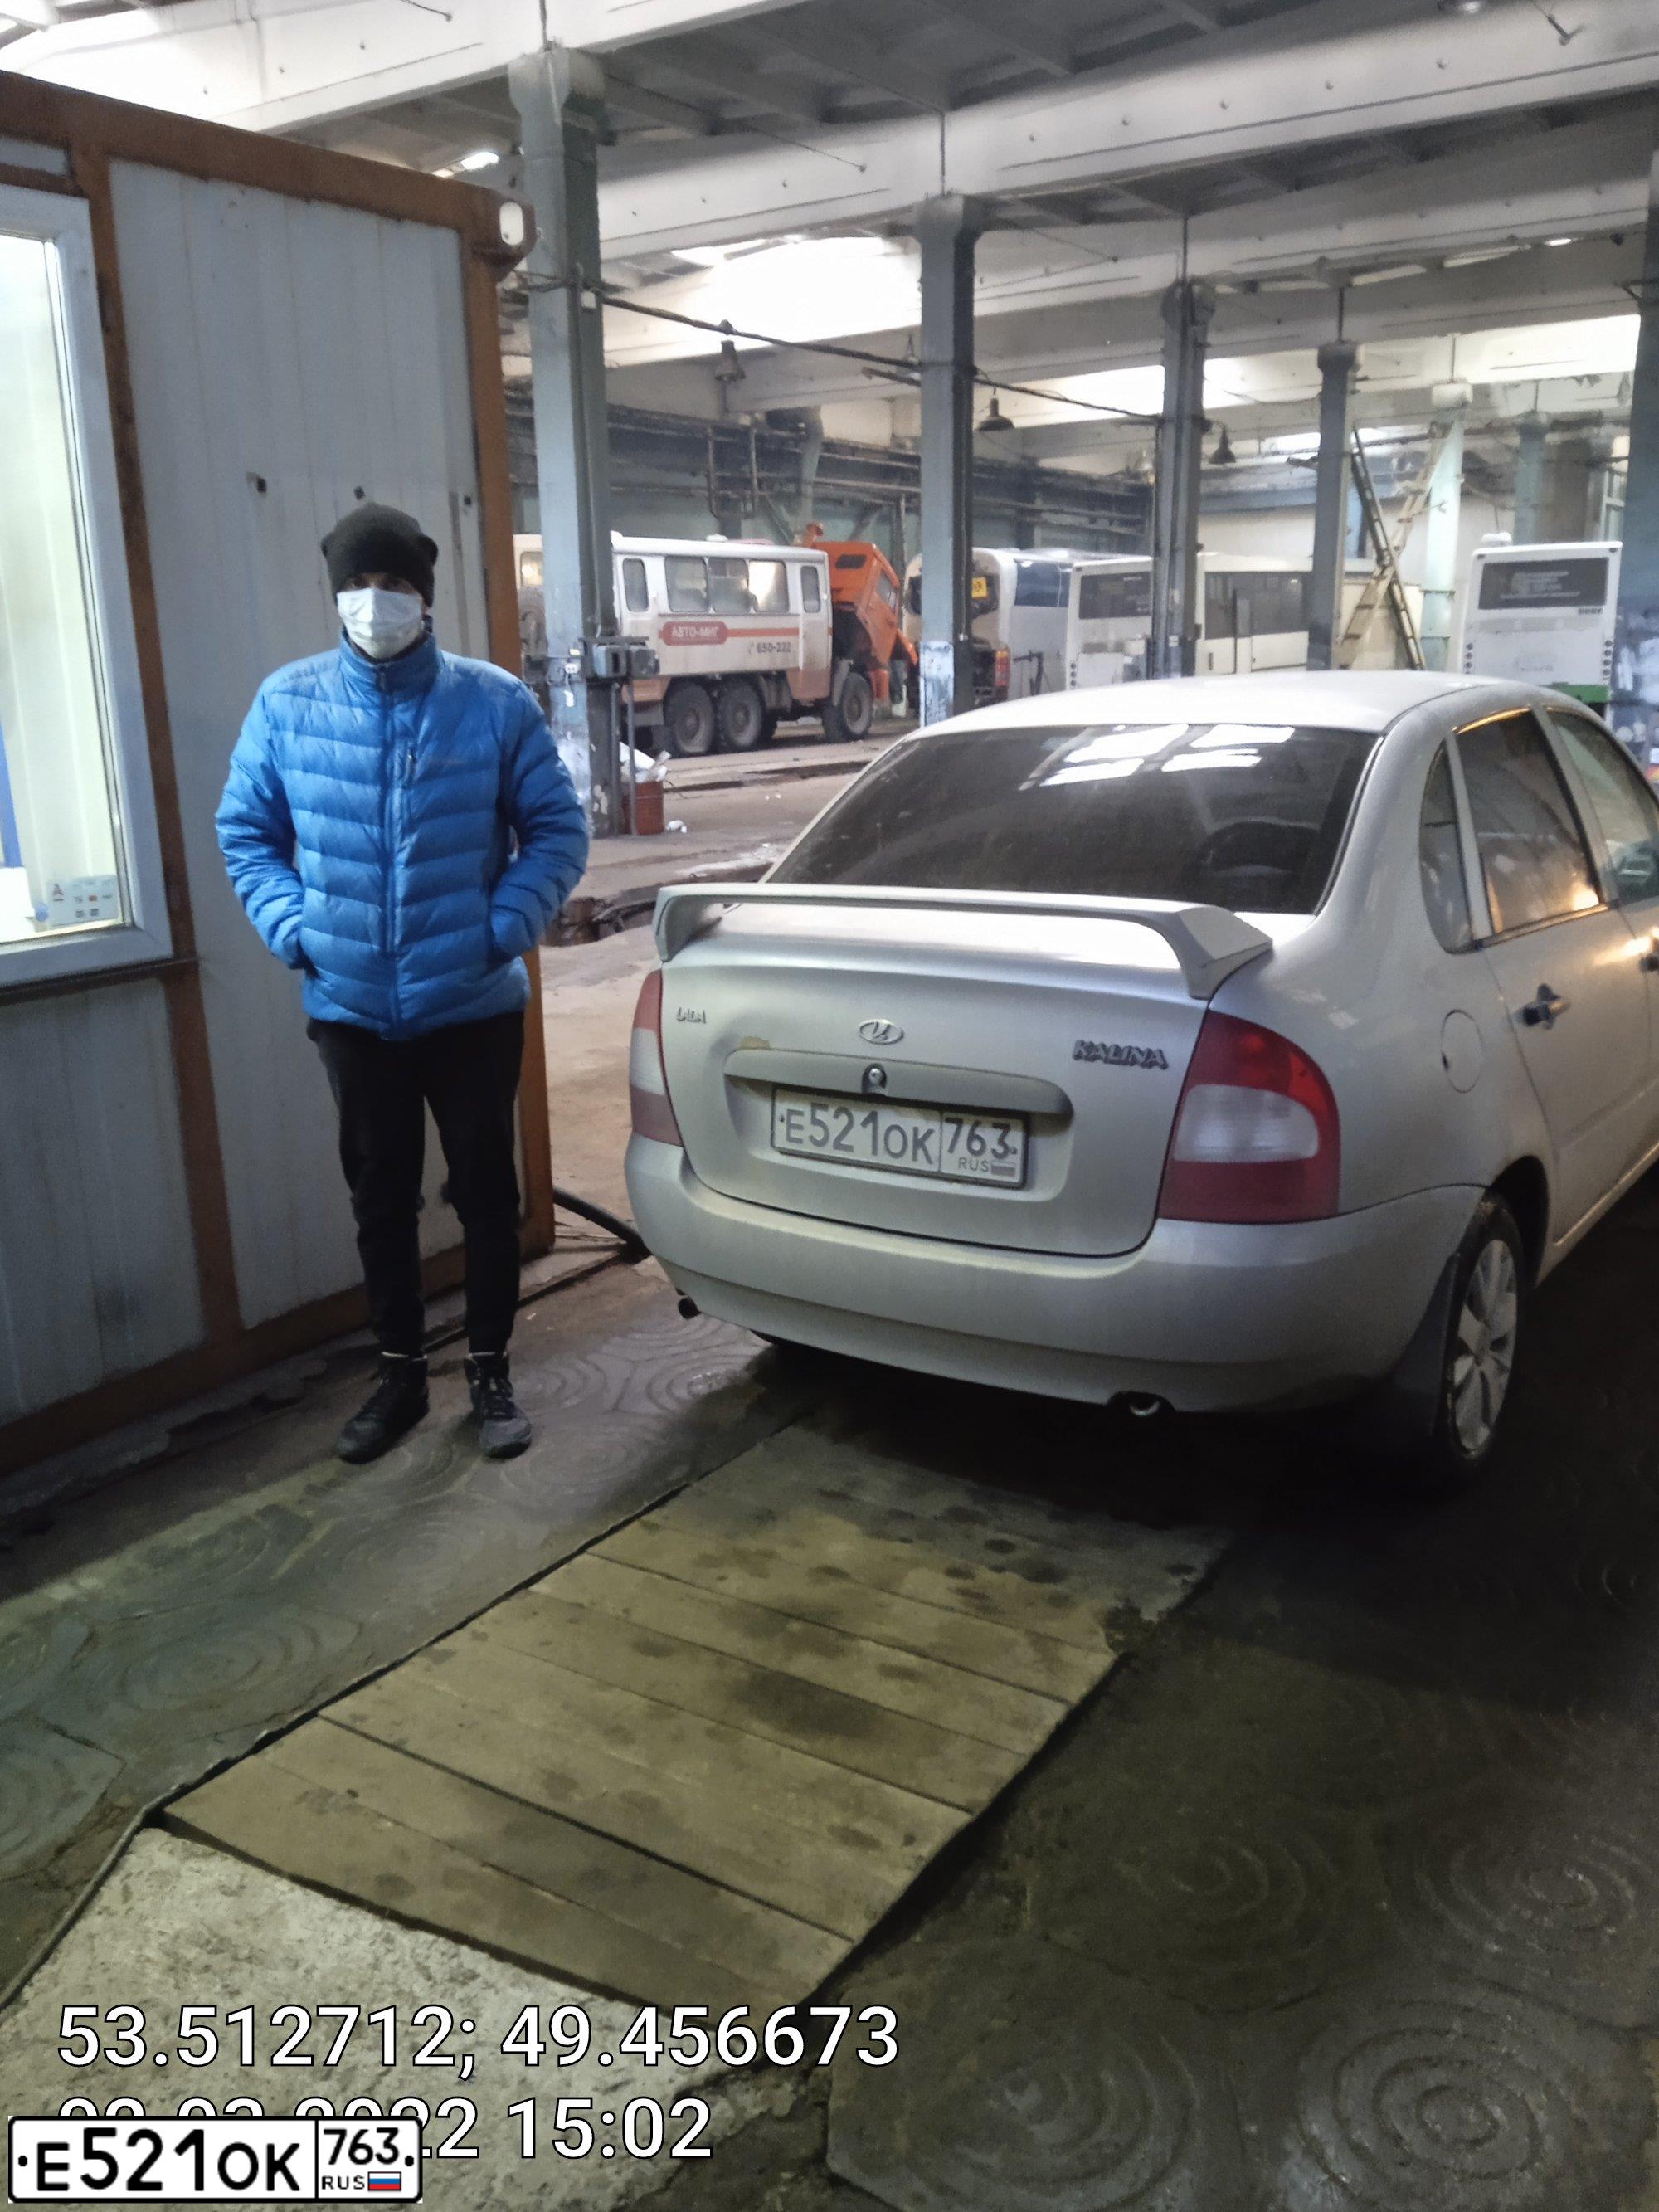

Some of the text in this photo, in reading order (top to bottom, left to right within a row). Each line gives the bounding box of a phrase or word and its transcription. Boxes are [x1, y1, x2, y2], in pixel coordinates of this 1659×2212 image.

[1072, 1039, 1169, 1070] KALINA
[945, 1117, 1011, 1161] 763
[958, 1156, 990, 1173] RUS
